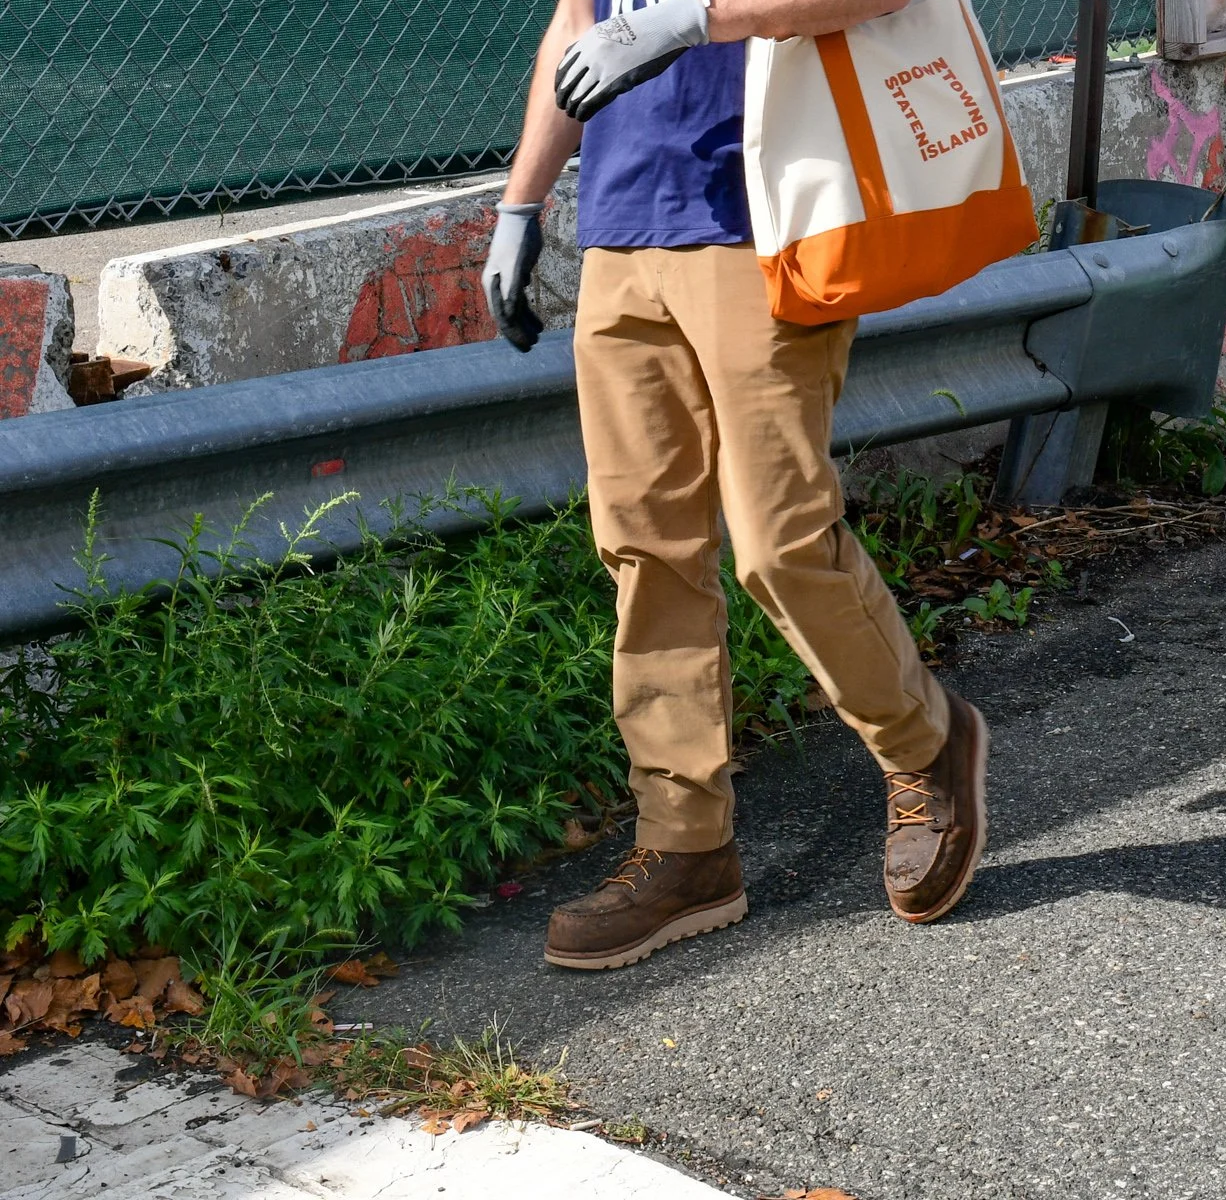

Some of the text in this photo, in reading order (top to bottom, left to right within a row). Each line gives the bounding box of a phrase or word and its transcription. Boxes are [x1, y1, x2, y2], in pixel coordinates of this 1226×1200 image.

[884, 76, 930, 148] STATEN
[897, 57, 984, 124] DOWNTOWN
[920, 121, 989, 162] ISLAND
